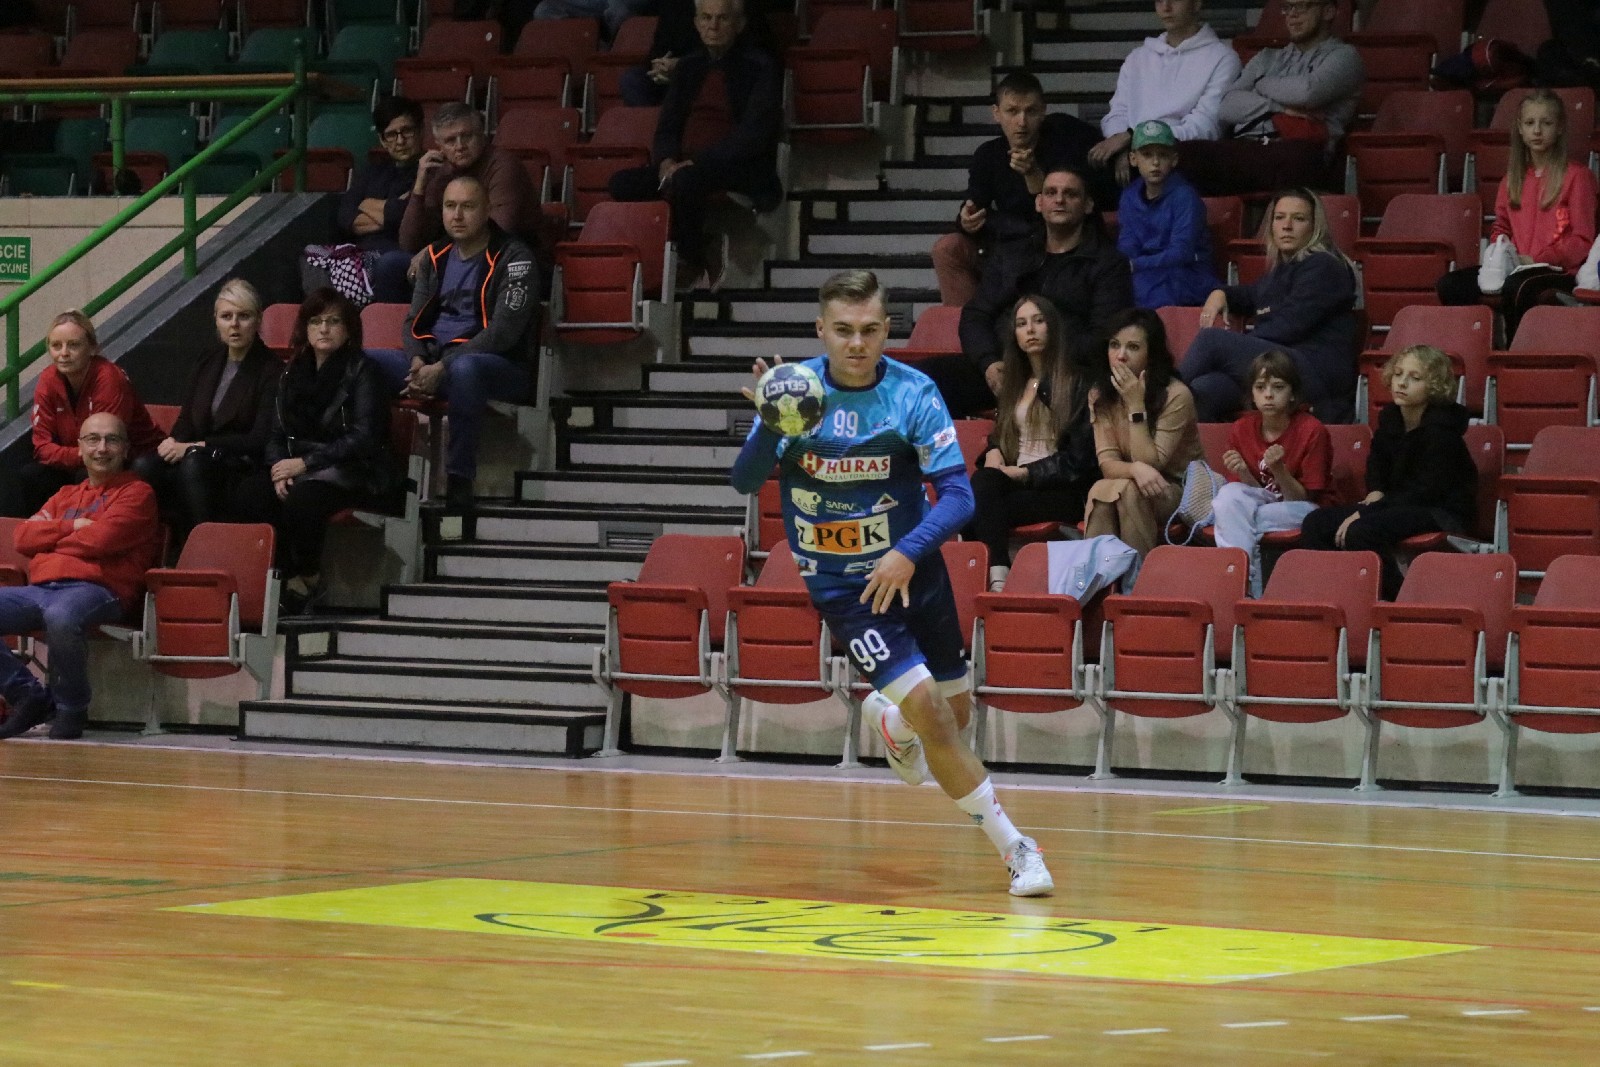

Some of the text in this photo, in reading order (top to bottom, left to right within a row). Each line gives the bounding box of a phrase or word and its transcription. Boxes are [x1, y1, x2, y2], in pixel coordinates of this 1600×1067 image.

[765, 379, 808, 398] SELECT
[833, 409, 859, 438] 99
[826, 458, 889, 474] HURAS
[798, 521, 887, 549] LPGK
[849, 628, 891, 673] 99
